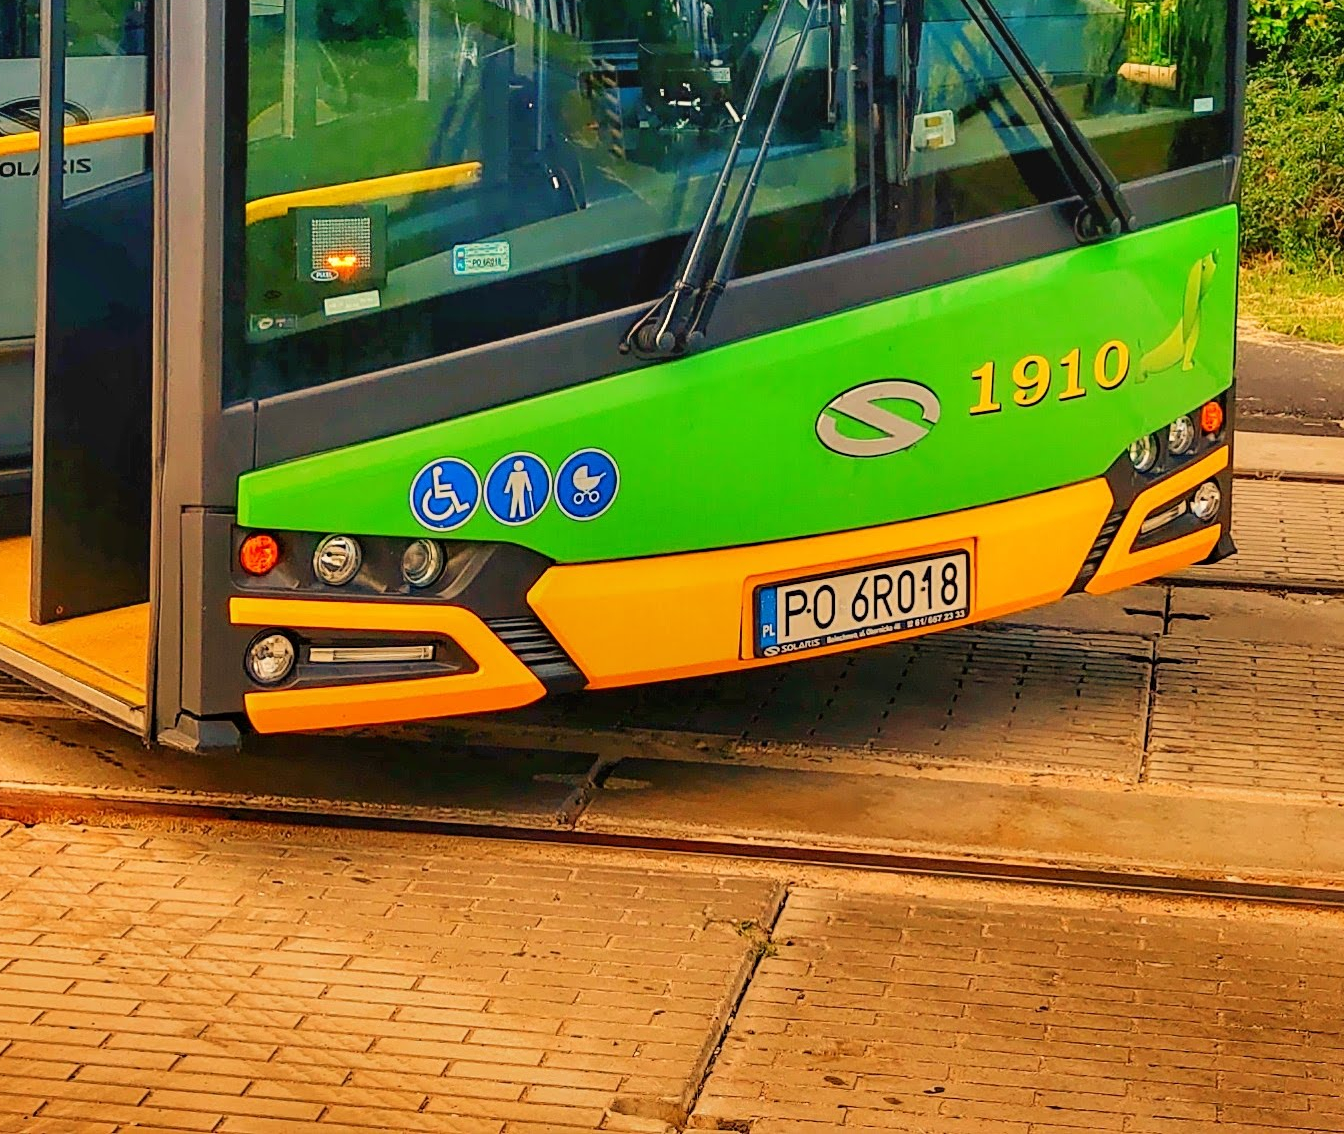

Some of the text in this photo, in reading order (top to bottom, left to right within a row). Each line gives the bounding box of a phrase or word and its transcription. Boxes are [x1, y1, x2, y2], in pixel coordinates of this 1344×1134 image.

[969, 339, 1131, 417] 1910
[762, 623, 776, 639] PL
[784, 583, 836, 637] PO
[851, 562, 958, 623] 6R018
[780, 637, 821, 654] SOLARIS
